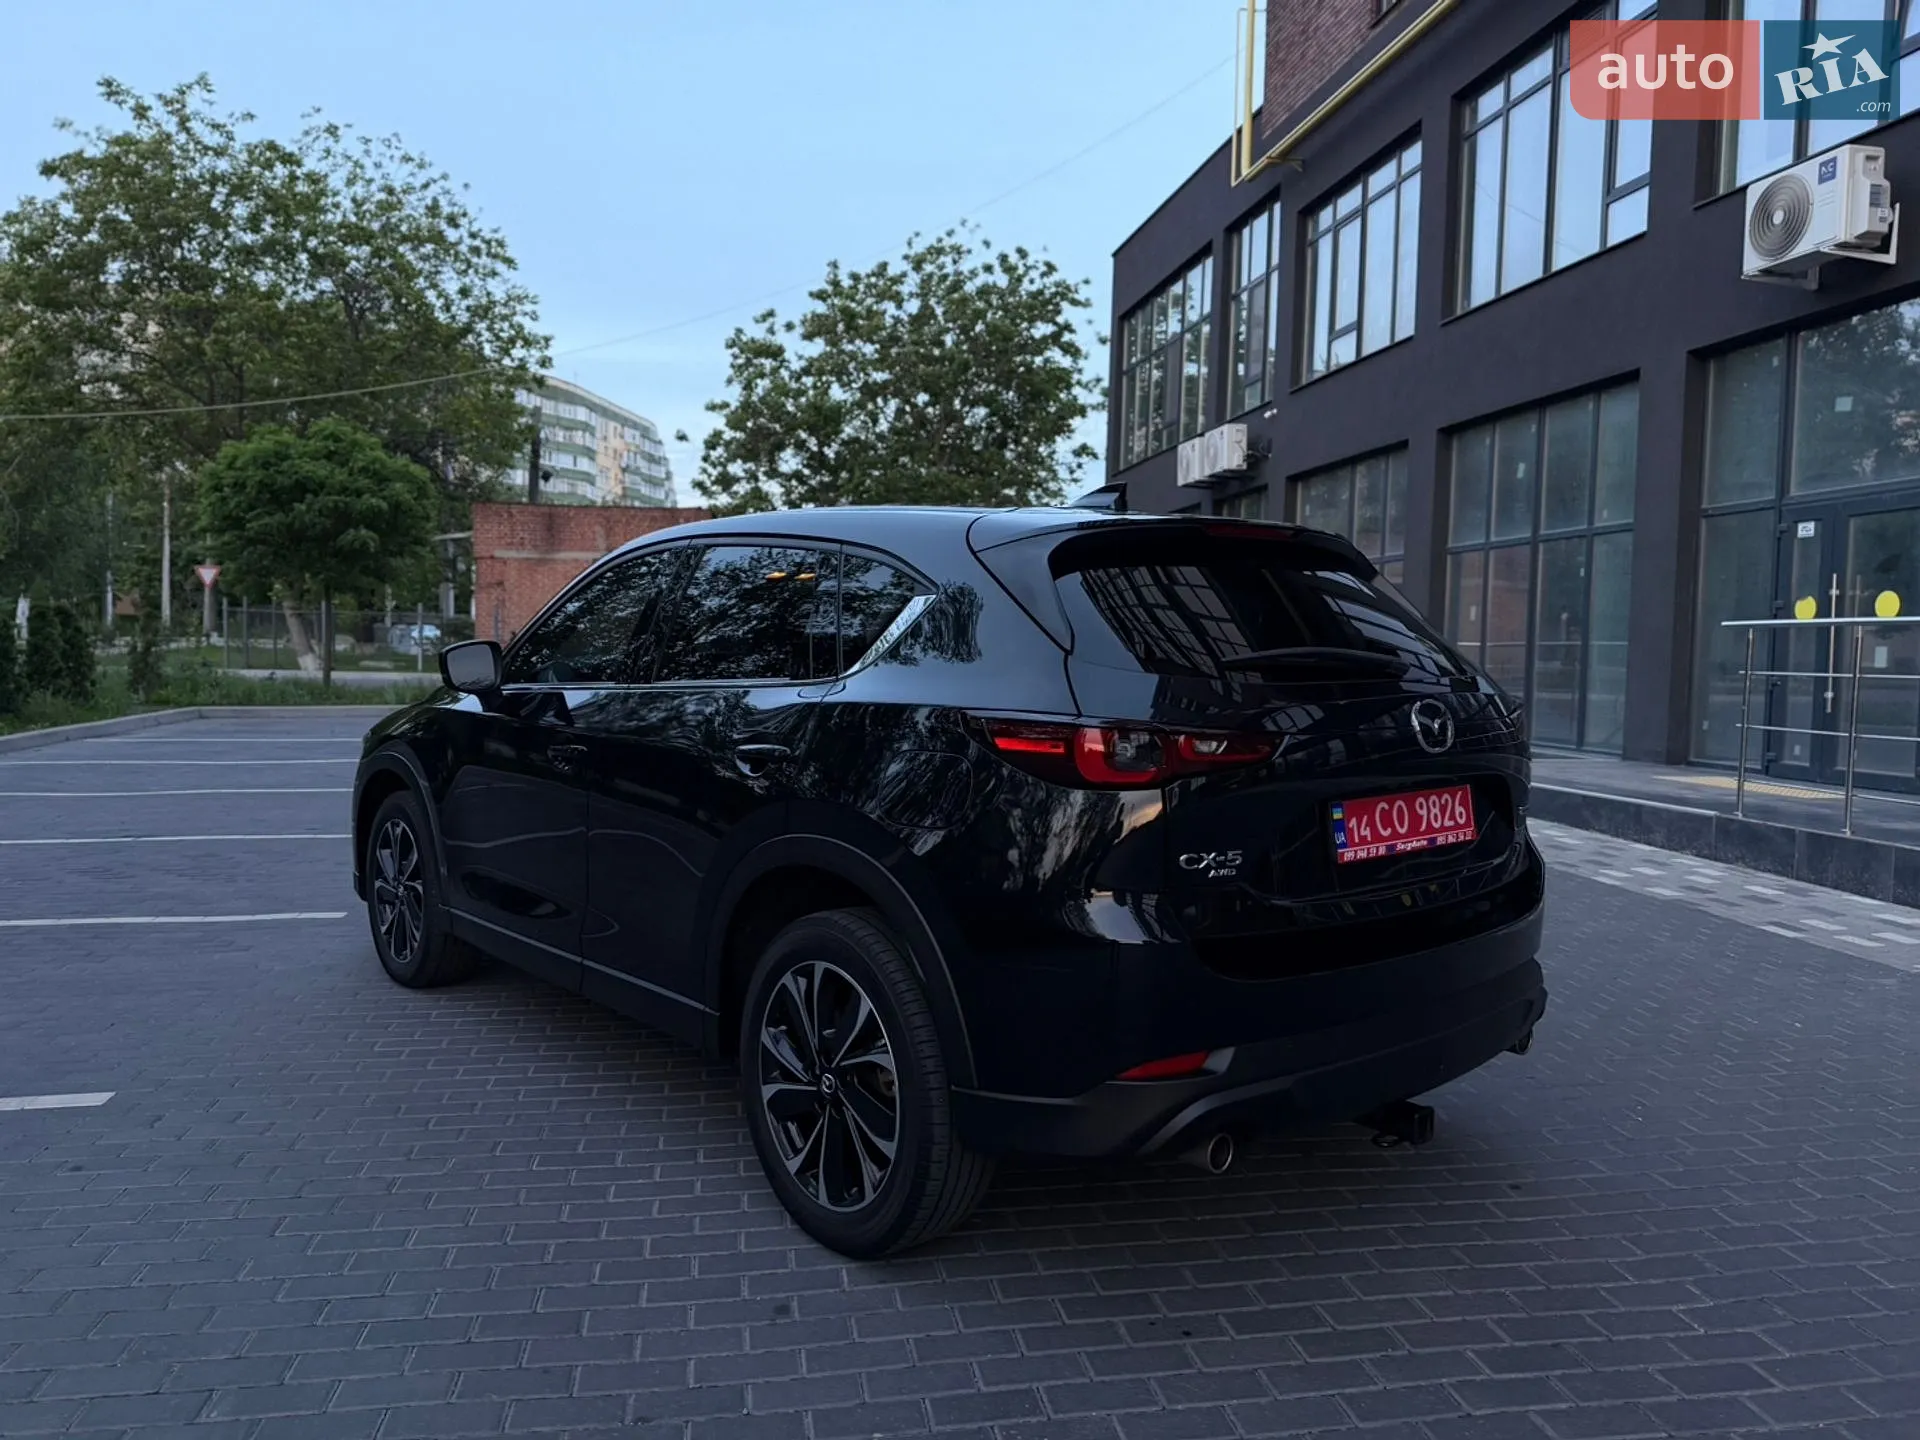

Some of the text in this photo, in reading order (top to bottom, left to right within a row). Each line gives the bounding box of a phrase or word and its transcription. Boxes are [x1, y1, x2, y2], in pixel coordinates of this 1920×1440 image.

[1348, 791, 1466, 843] 14 CO 9826
[1335, 832, 1346, 844] UA
[1178, 850, 1243, 869] CX-5
[1208, 868, 1236, 878] AWD
